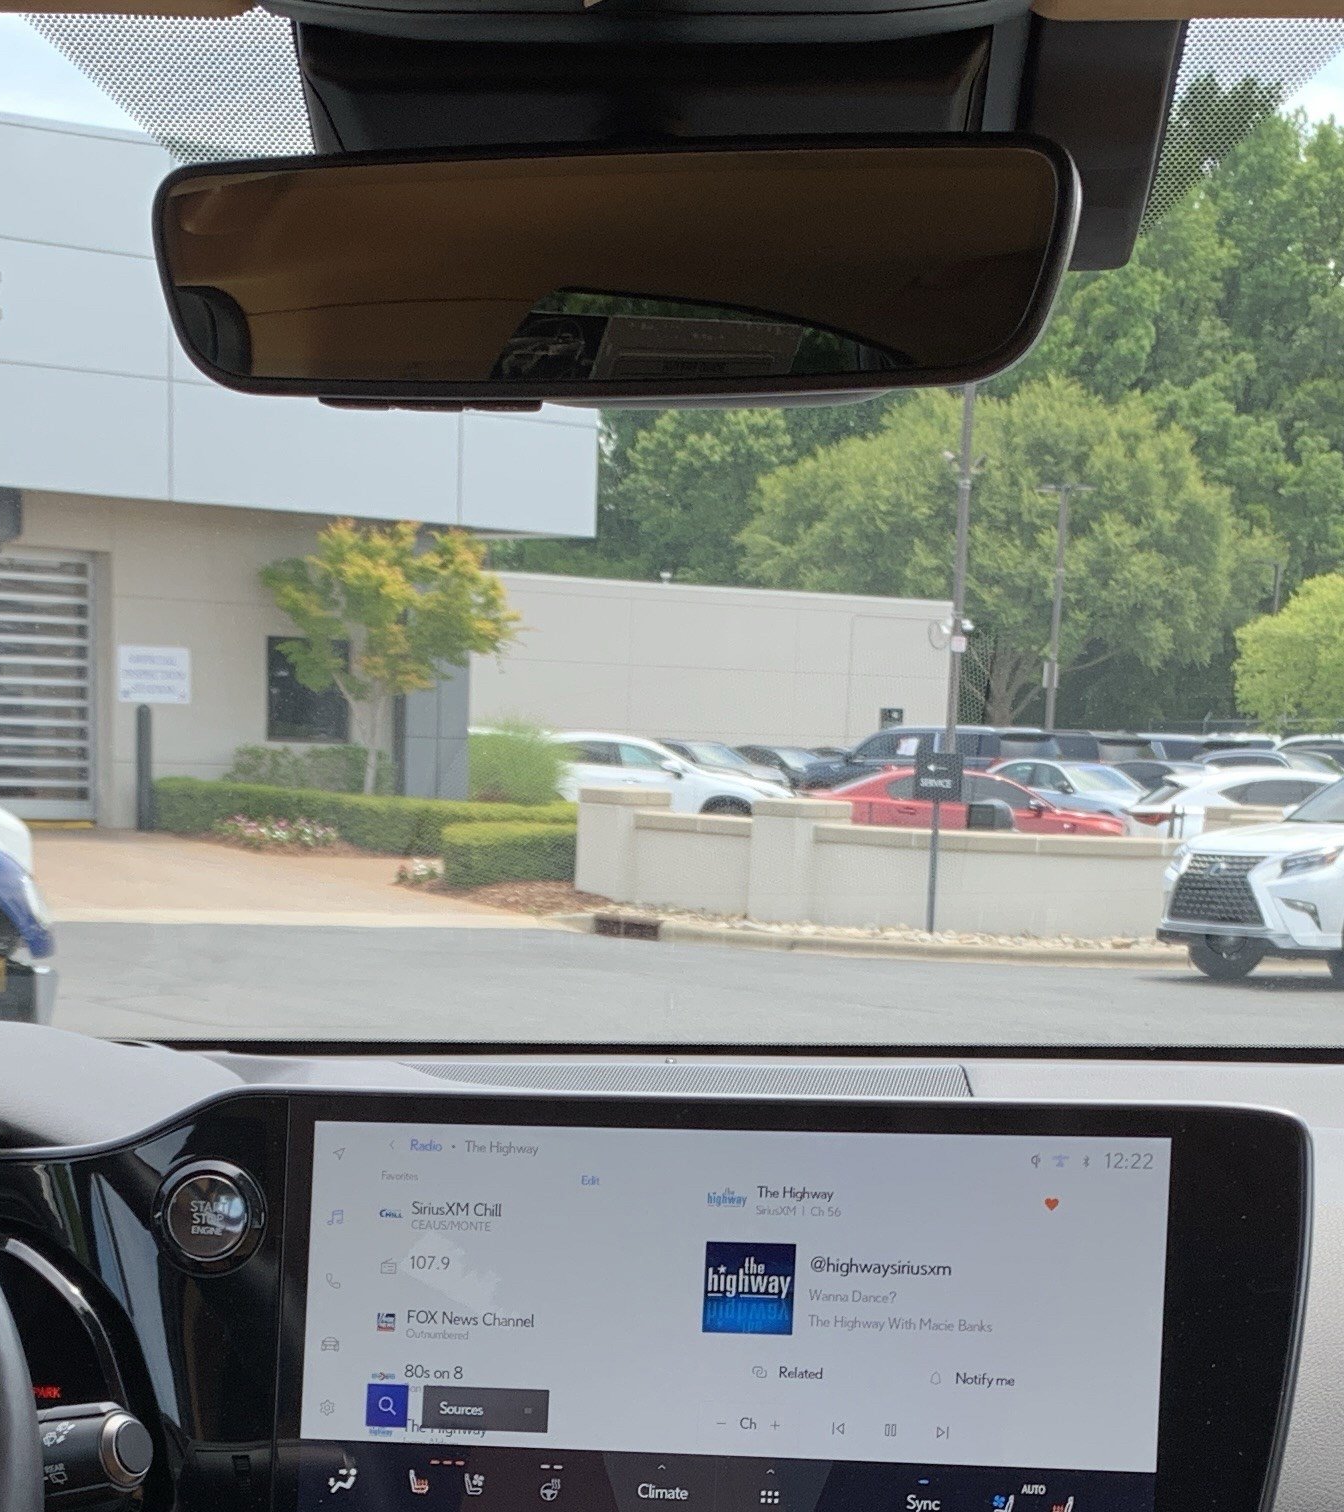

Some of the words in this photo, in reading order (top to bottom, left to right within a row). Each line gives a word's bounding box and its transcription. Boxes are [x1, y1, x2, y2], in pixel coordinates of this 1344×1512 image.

[409, 1138, 444, 1153] Radio
[464, 1140, 487, 1153] The
[489, 1141, 539, 1158] Highway
[1105, 1152, 1154, 1170] 12:22
[381, 1169, 419, 1182] Favorites
[581, 1175, 601, 1187] Edit
[757, 1185, 780, 1199] The
[782, 1187, 834, 1202] Highway
[411, 1201, 470, 1218] SiriusXM
[473, 1203, 503, 1218] Chill
[756, 1205, 797, 1217] SiriusXM
[810, 1206, 825, 1217] Ch
[827, 1207, 842, 1218] 56
[410, 1256, 451, 1271] 107.9
[743, 1256, 766, 1276] the
[810, 1256, 953, 1278] @highwaysiriusxm
[707, 1264, 792, 1299] highway
[808, 1288, 849, 1303] Wanna
[852, 1290, 898, 1304] Dance?
[406, 1310, 439, 1325] FOX
[441, 1311, 479, 1327] News
[482, 1312, 535, 1328] Channel
[808, 1315, 831, 1329] The
[833, 1316, 886, 1333] Highway
[887, 1317, 917, 1331] With
[919, 1317, 955, 1332] Macie
[957, 1319, 994, 1334] Banks
[405, 1329, 469, 1341] Outnumbered
[404, 1364, 431, 1380] 80s
[433, 1370, 450, 1380] on
[453, 1365, 464, 1381] 8
[778, 1366, 824, 1381] Related
[955, 1372, 994, 1388] Notify
[996, 1377, 1016, 1388] me
[439, 1401, 485, 1416] Sources
[739, 1416, 758, 1431] Ch
[637, 1483, 690, 1501] Climate
[1021, 1484, 1047, 1496] AUTO
[906, 1494, 941, 1512] Sync
